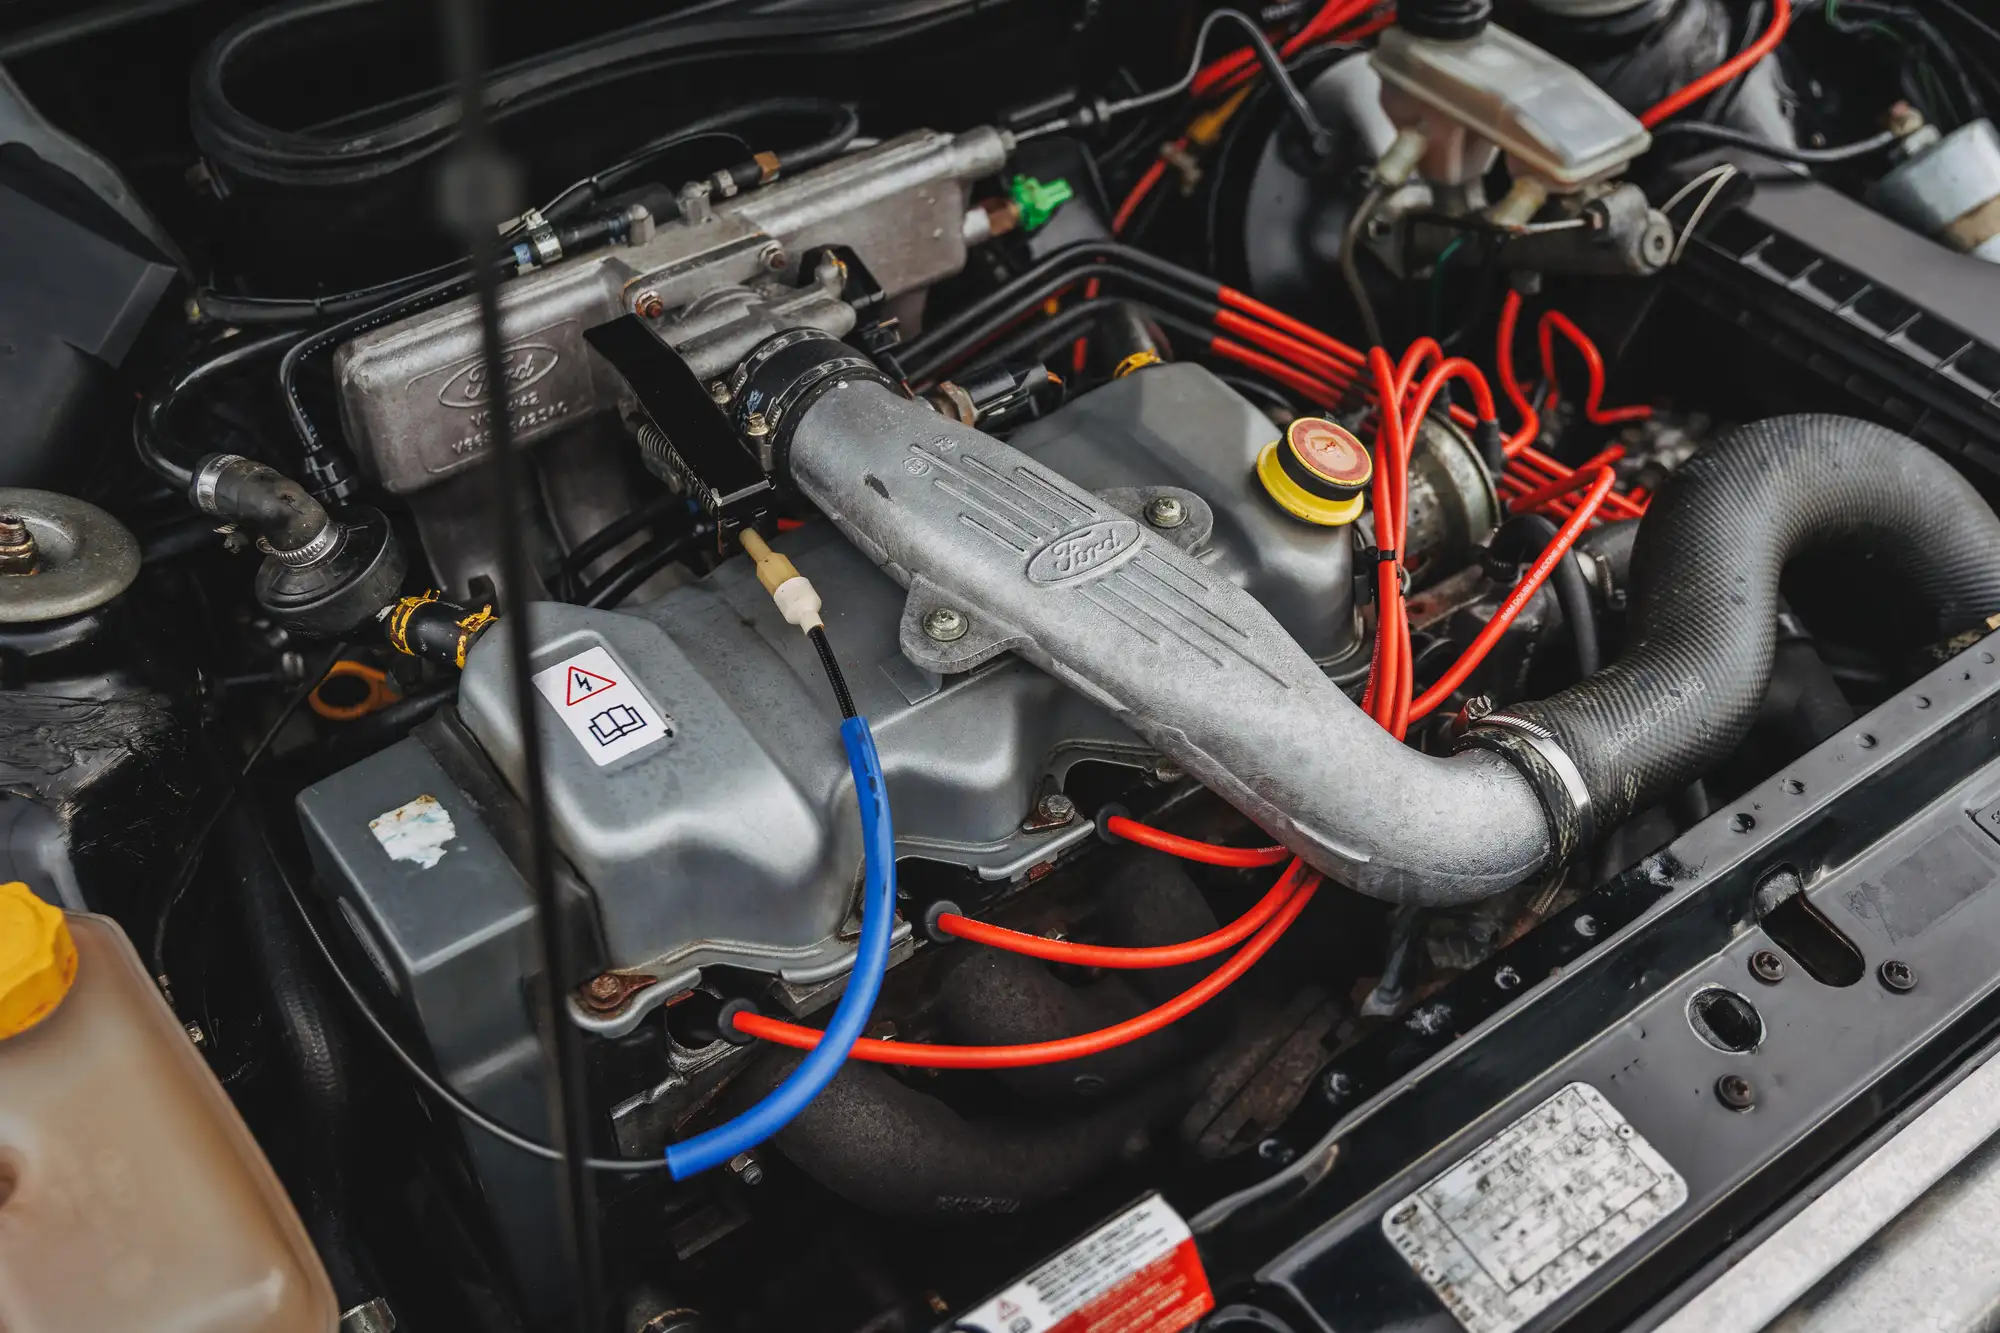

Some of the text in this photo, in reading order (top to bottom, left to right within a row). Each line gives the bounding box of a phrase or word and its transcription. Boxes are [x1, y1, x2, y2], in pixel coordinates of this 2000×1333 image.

[1052, 529, 1121, 572] Ford
[1513, 577, 1536, 606] DOUBLE
[1533, 549, 1559, 579] SILICONE
